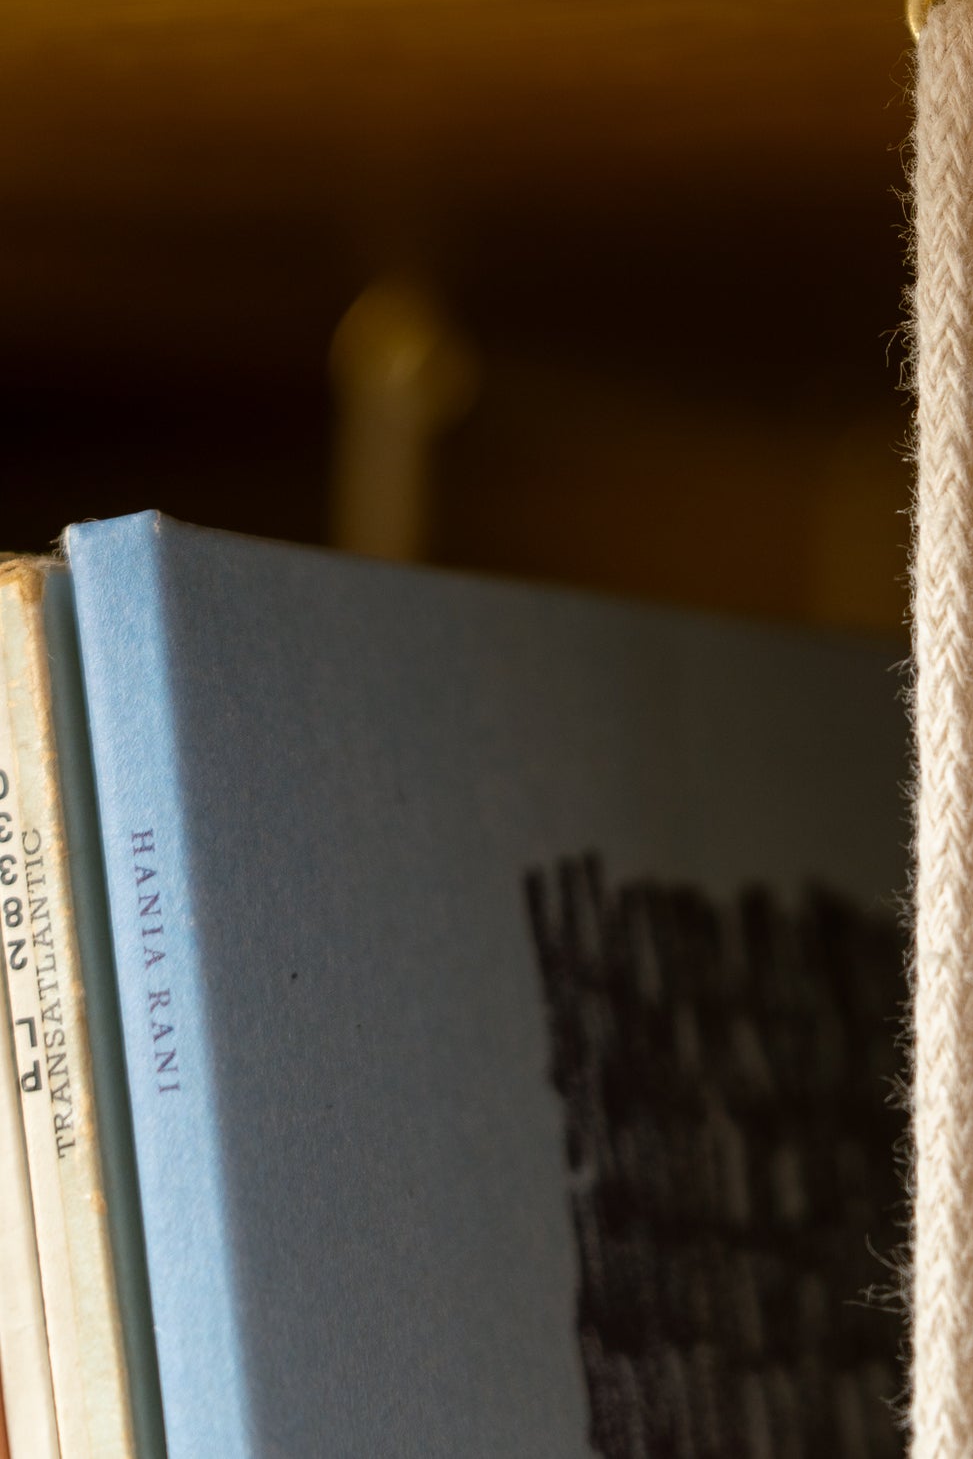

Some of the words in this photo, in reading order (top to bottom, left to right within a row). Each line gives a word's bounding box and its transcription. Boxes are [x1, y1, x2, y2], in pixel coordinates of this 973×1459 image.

[22, 828, 76, 1159] TRANSATLANTIC
[132, 828, 166, 970] HANIA
[149, 988, 181, 1093] RANI
